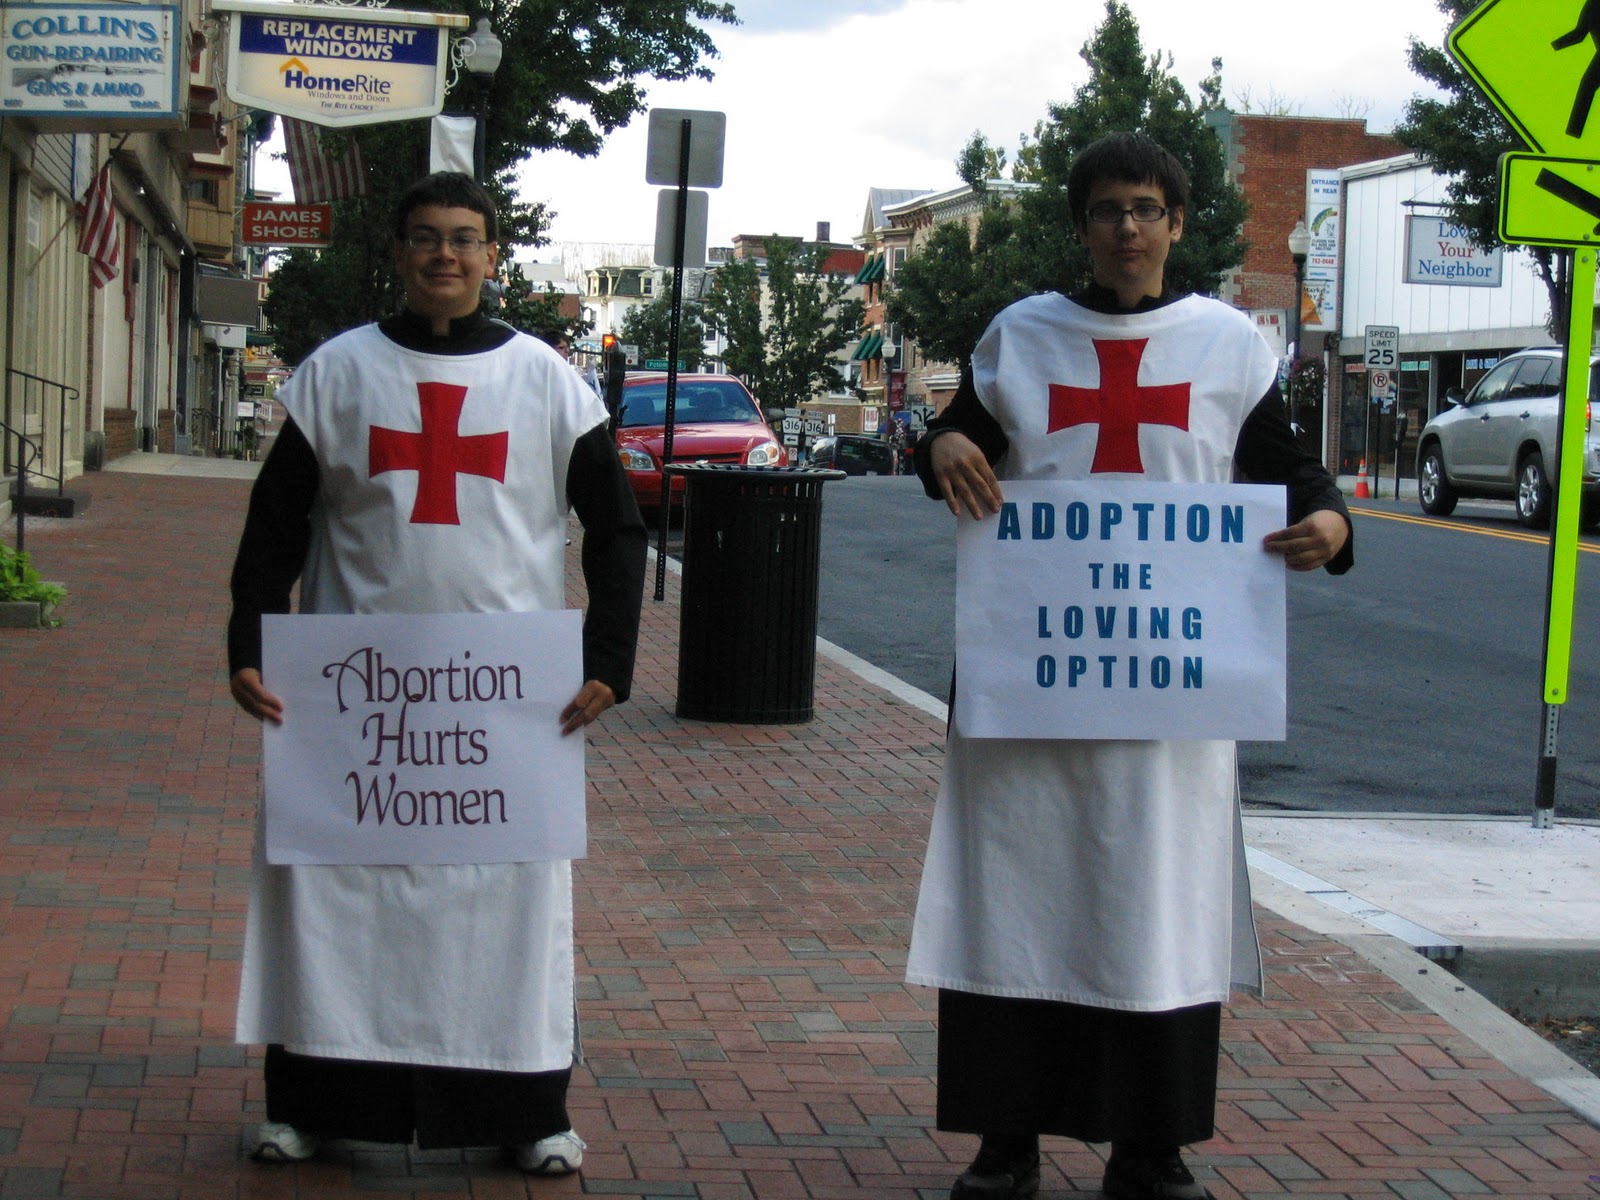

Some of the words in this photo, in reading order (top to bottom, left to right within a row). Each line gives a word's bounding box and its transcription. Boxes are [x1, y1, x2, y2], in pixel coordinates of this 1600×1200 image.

[12, 15, 159, 44] COLLIN'S
[263, 20, 417, 46] REPLACEMENT
[6, 44, 164, 63] GUN-REPAIRING
[285, 38, 393, 60] WINDOWS
[27, 81, 73, 97] GUNS
[75, 82, 89, 96] &
[92, 82, 145, 97] AMMO
[284, 70, 391, 95] HomeRite
[308, 90, 345, 100] Windows
[347, 93, 363, 101] and
[366, 94, 390, 102] Doors
[252, 209, 322, 224] JAMES
[252, 225, 321, 239] SHOES
[1438, 223, 1472, 238] Lov
[1437, 241, 1475, 258] Your
[1418, 260, 1492, 279] Neighbor
[1368, 349, 1394, 365] 25
[784, 421, 800, 430] 316
[806, 423, 821, 432] 316
[997, 501, 1244, 543] ADOPTION
[1089, 563, 1152, 590] THE
[1038, 606, 1202, 640] LOVING
[322, 647, 524, 713] Abortion
[1036, 655, 1203, 689] OPTION
[362, 694, 489, 766] Hurts
[345, 771, 509, 827] Women
